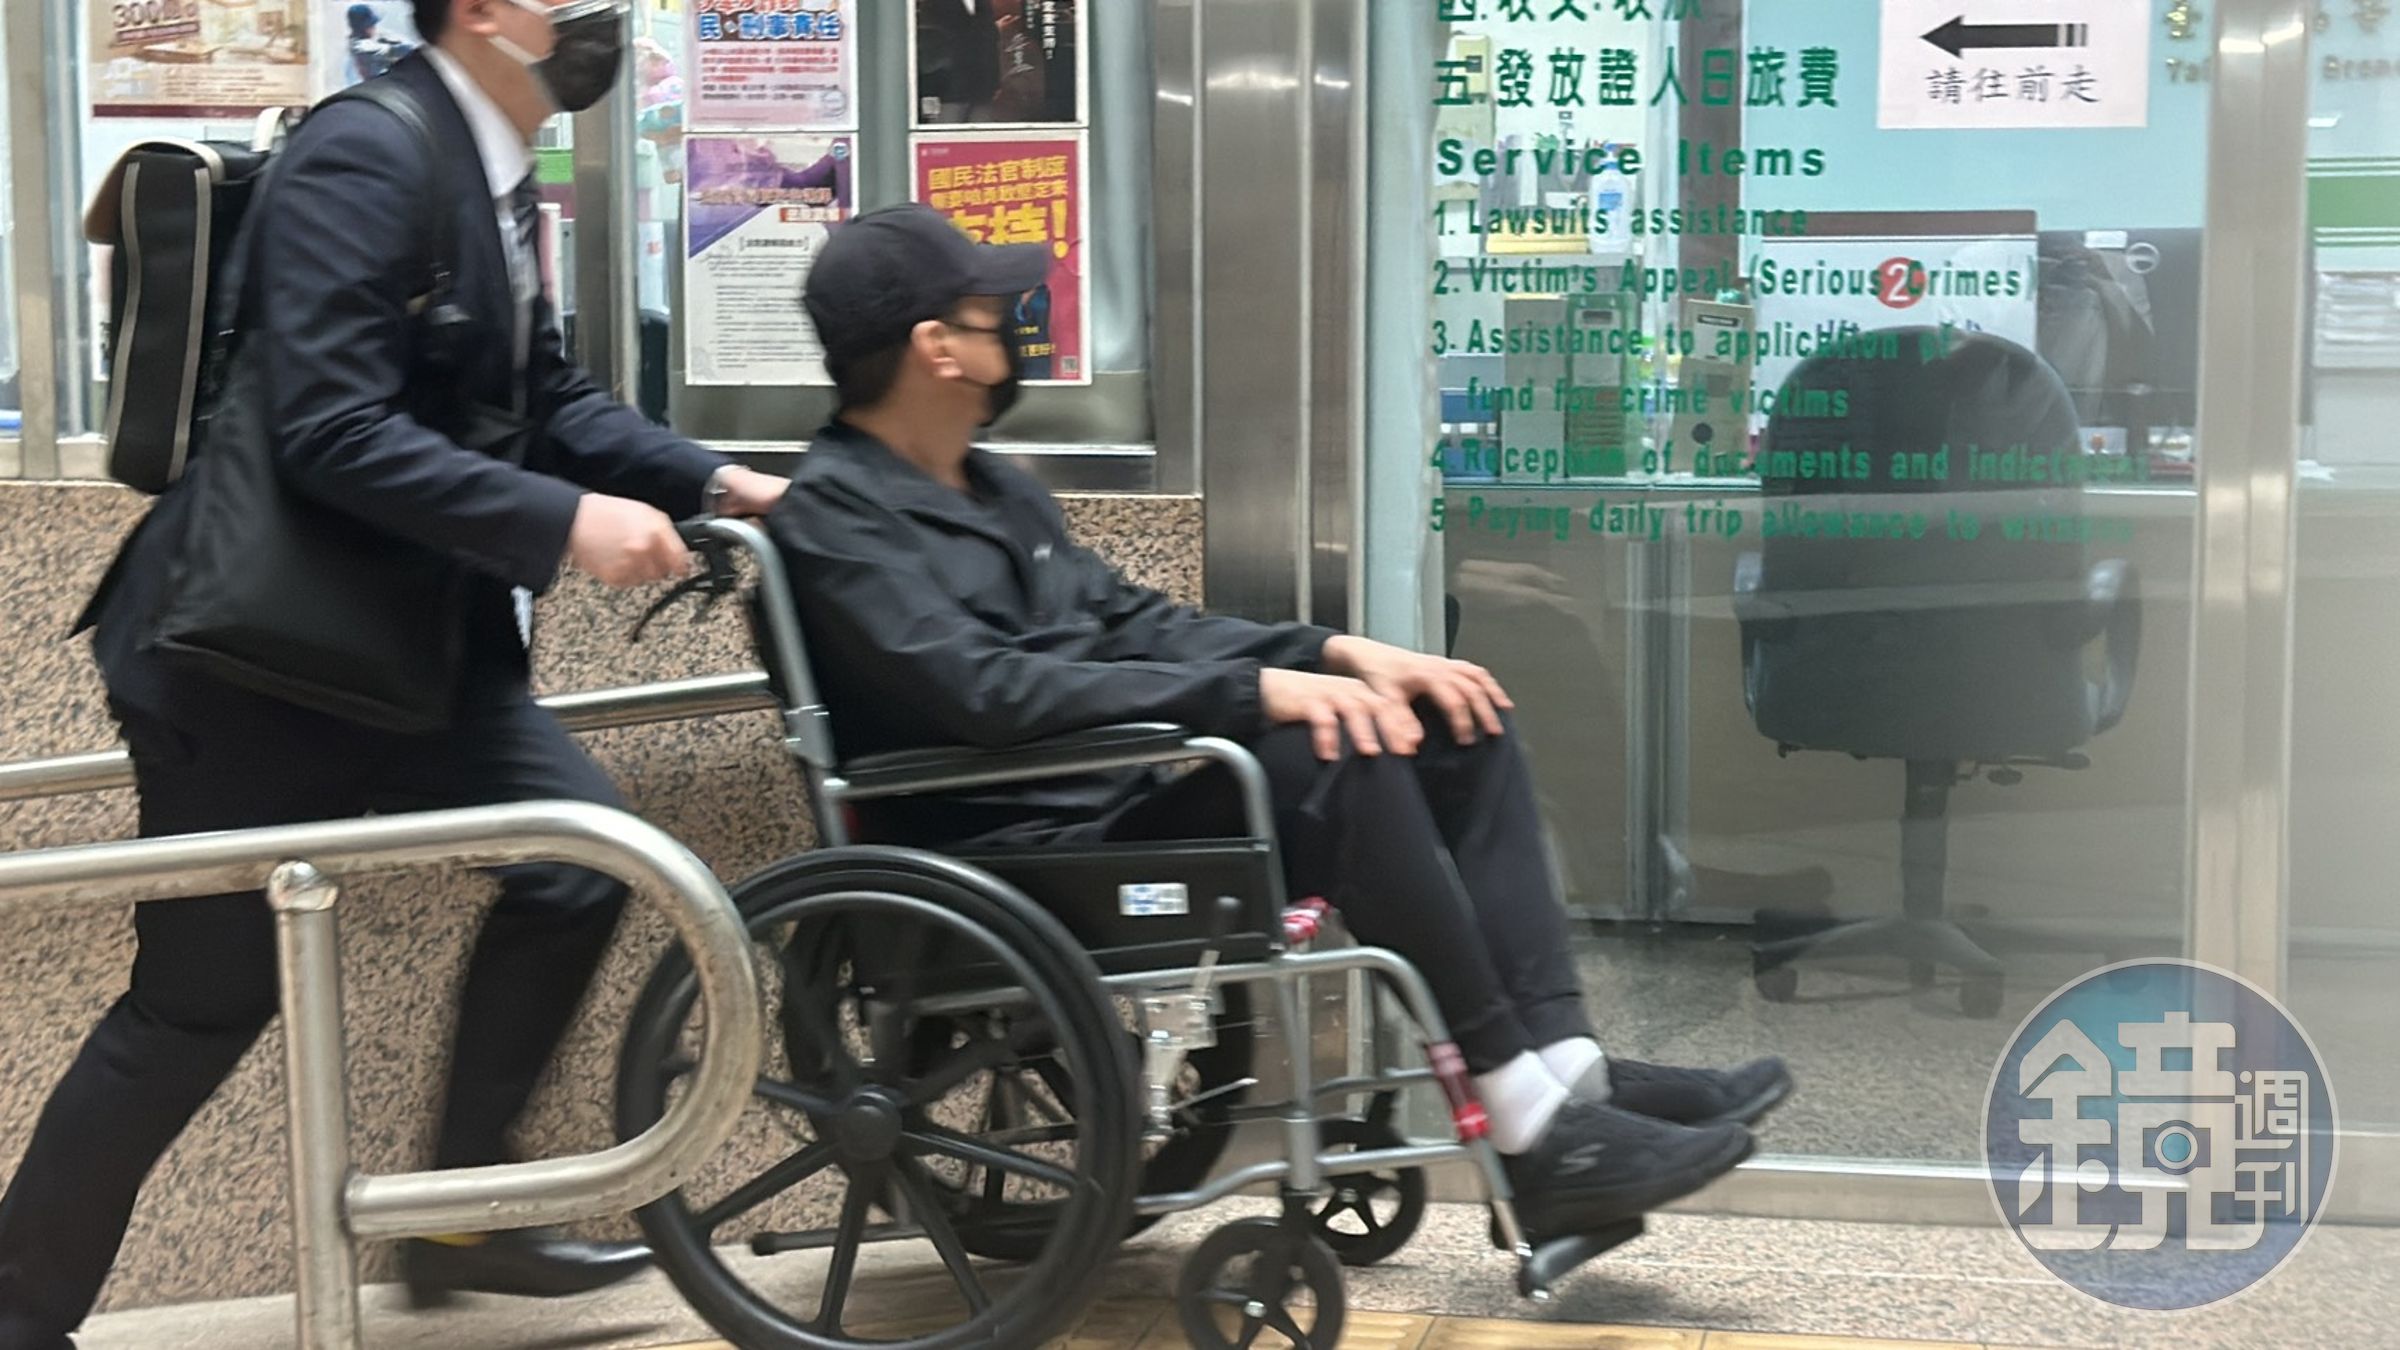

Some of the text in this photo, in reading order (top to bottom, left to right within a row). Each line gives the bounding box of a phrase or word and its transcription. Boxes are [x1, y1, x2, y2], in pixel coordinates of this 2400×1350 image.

[1925, 64, 2100, 104] 請往前走
[1437, 138, 1826, 176] Service Items
[1631, 204, 1807, 235] assistance
[1619, 258, 1733, 302] Appeal
[1747, 254, 1881, 300] (Serious
[1666, 322, 1695, 356] to
[1467, 377, 1533, 414] fund
[1620, 380, 1709, 415] crime
[1731, 380, 1848, 418] victims
[1643, 441, 1674, 475] of
[1891, 443, 1950, 481] and
[1467, 496, 1571, 541] Paying
[1589, 497, 1664, 541] daily
[1686, 500, 1743, 538] trip
[1945, 508, 1981, 541] to
